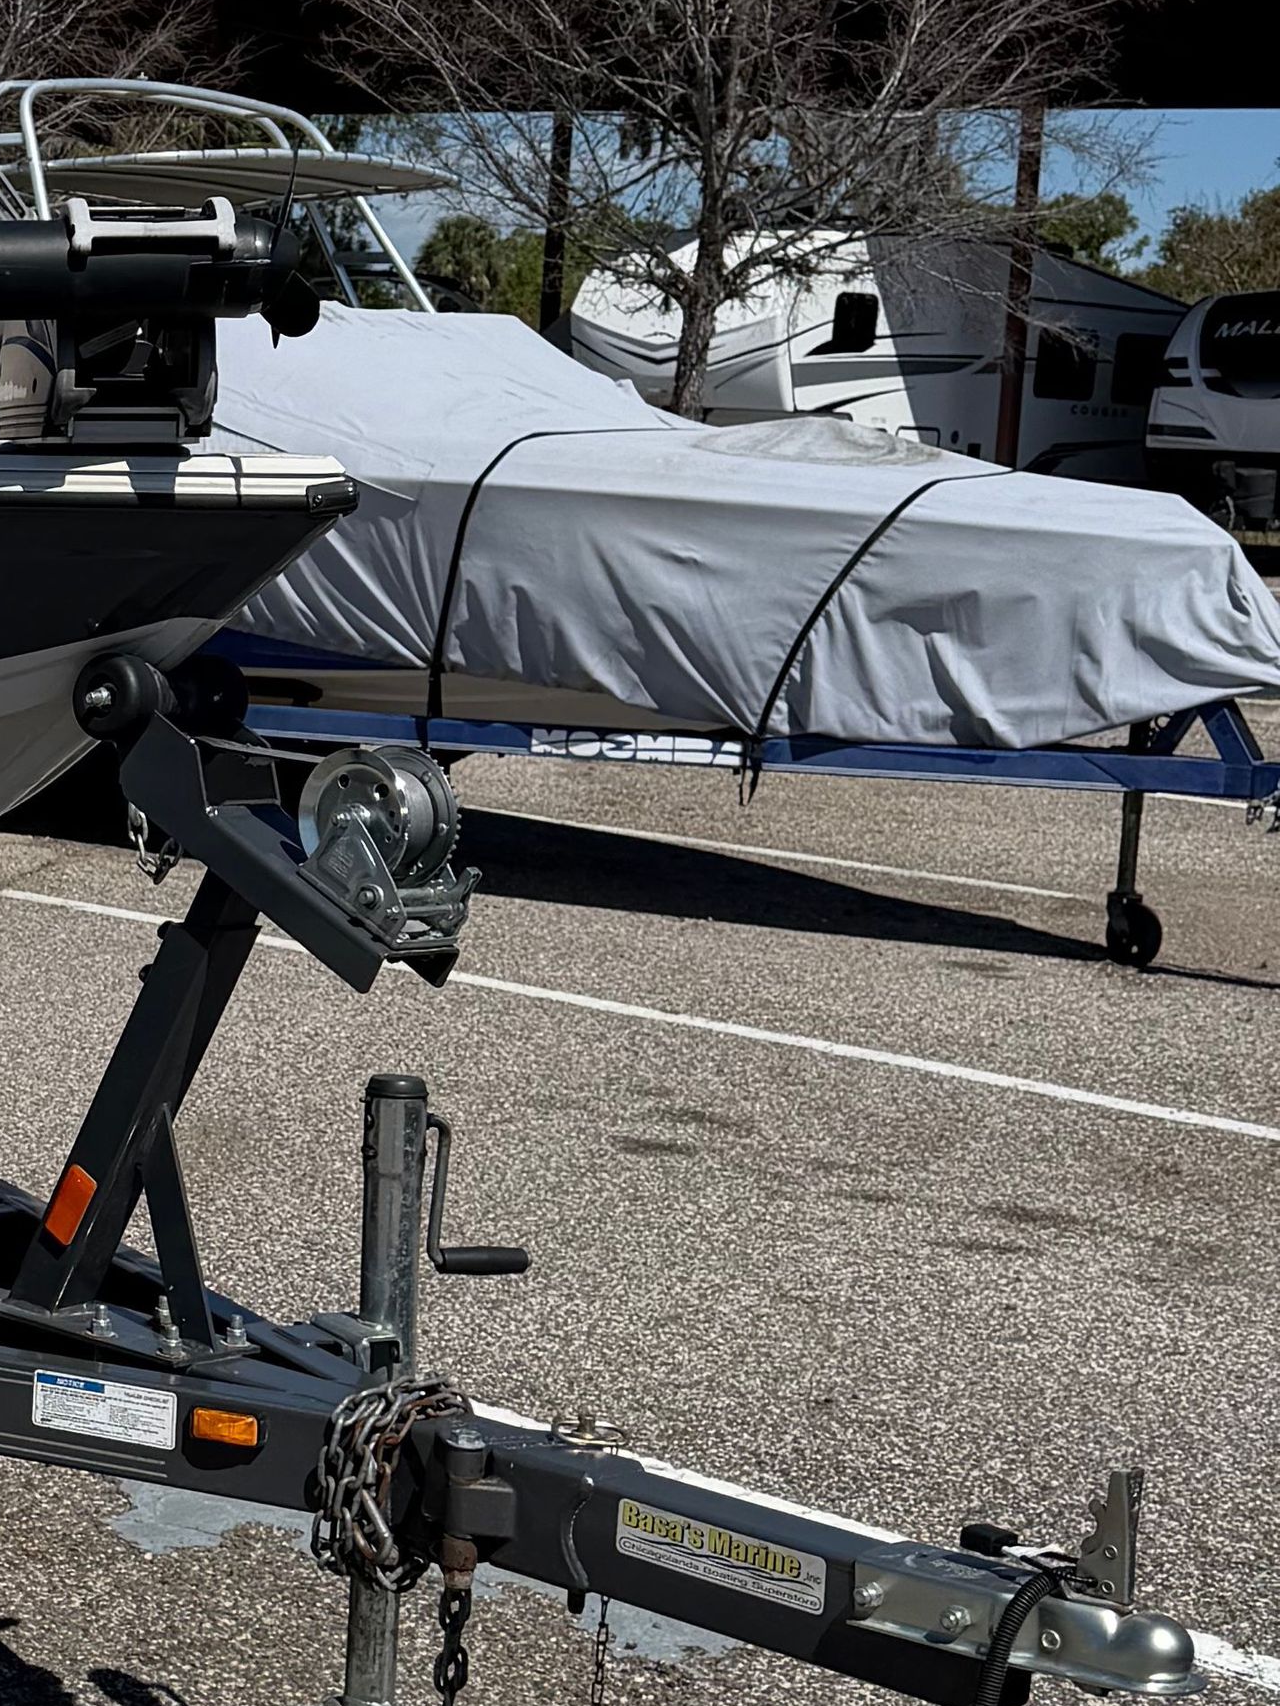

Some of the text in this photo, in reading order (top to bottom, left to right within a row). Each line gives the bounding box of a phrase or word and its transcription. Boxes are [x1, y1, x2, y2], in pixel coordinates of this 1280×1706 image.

[55, 1377, 86, 1389] NOTICE
[622, 1501, 705, 1551] Basa's
[707, 1527, 802, 1579] Marine
[622, 1539, 819, 1609] Chicagolands Boating Superstore
